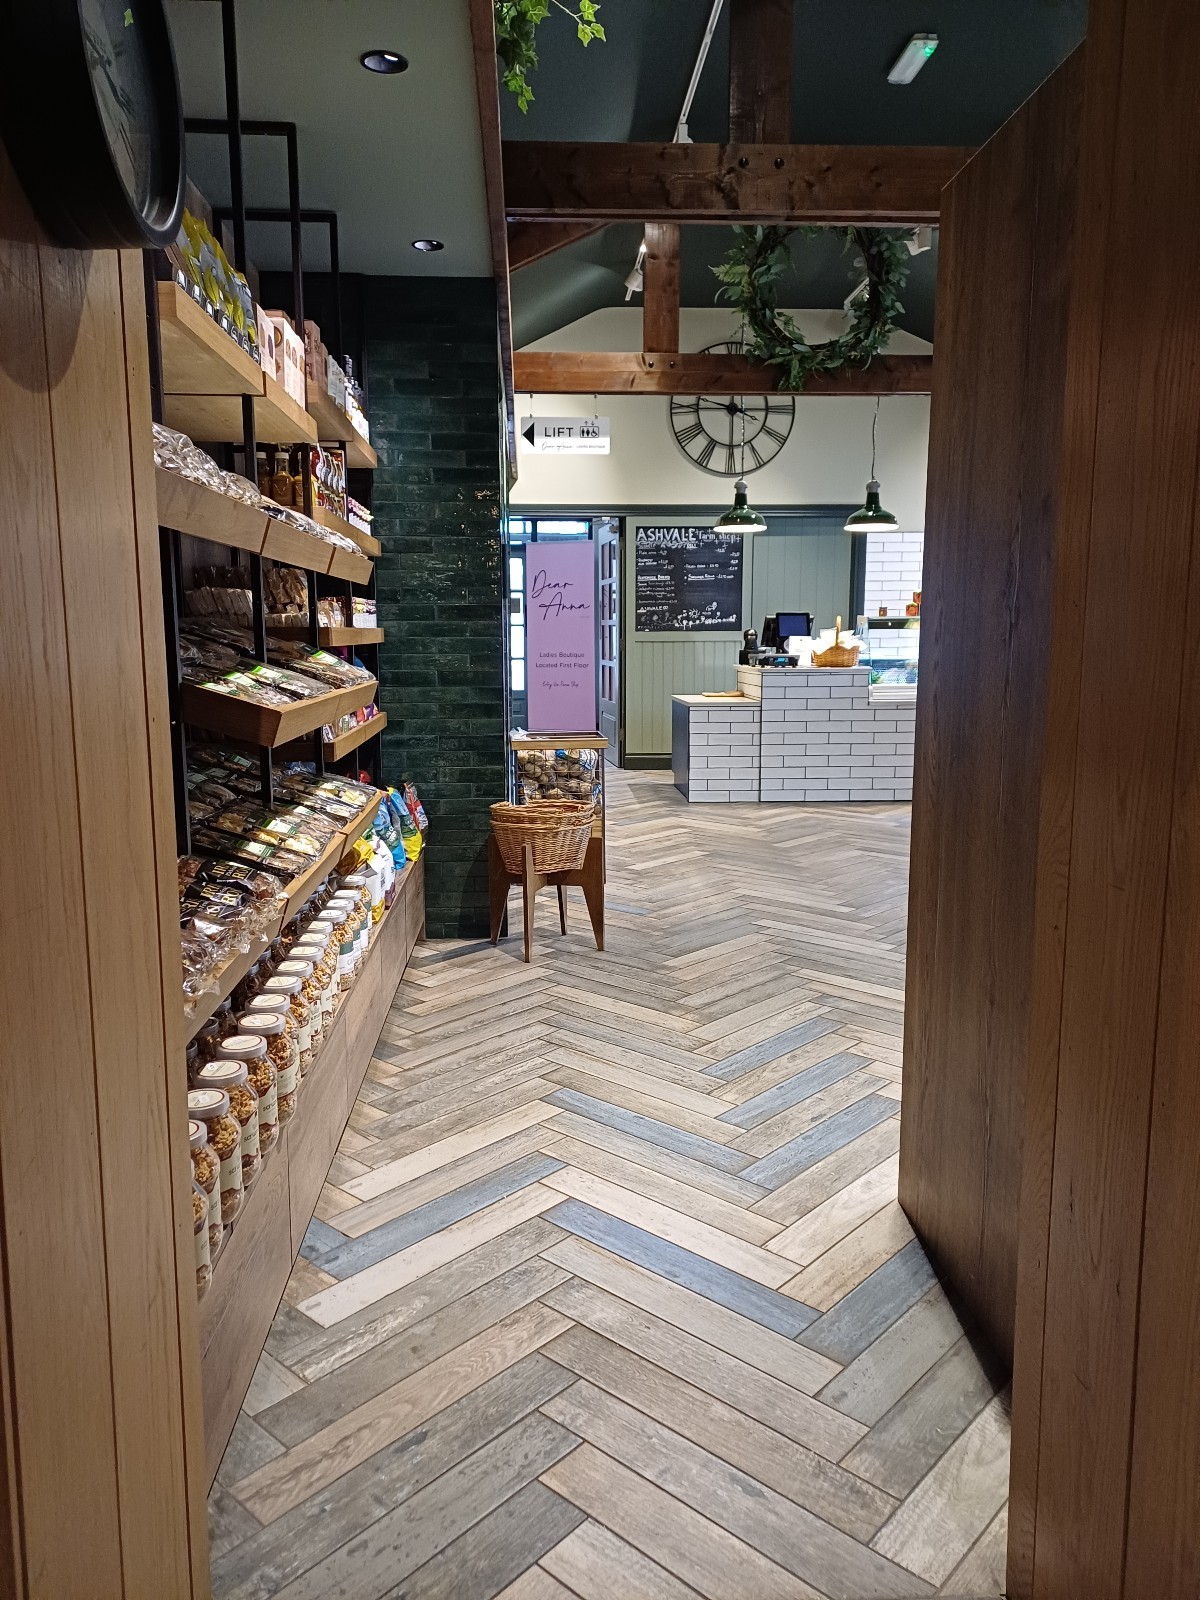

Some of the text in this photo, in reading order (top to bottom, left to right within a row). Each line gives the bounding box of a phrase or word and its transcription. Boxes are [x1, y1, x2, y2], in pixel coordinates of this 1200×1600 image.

[544, 427, 574, 437] LIFT
[637, 528, 697, 541] ASHVALE
[532, 569, 573, 598] Dear
[539, 592, 590, 620] Anna
